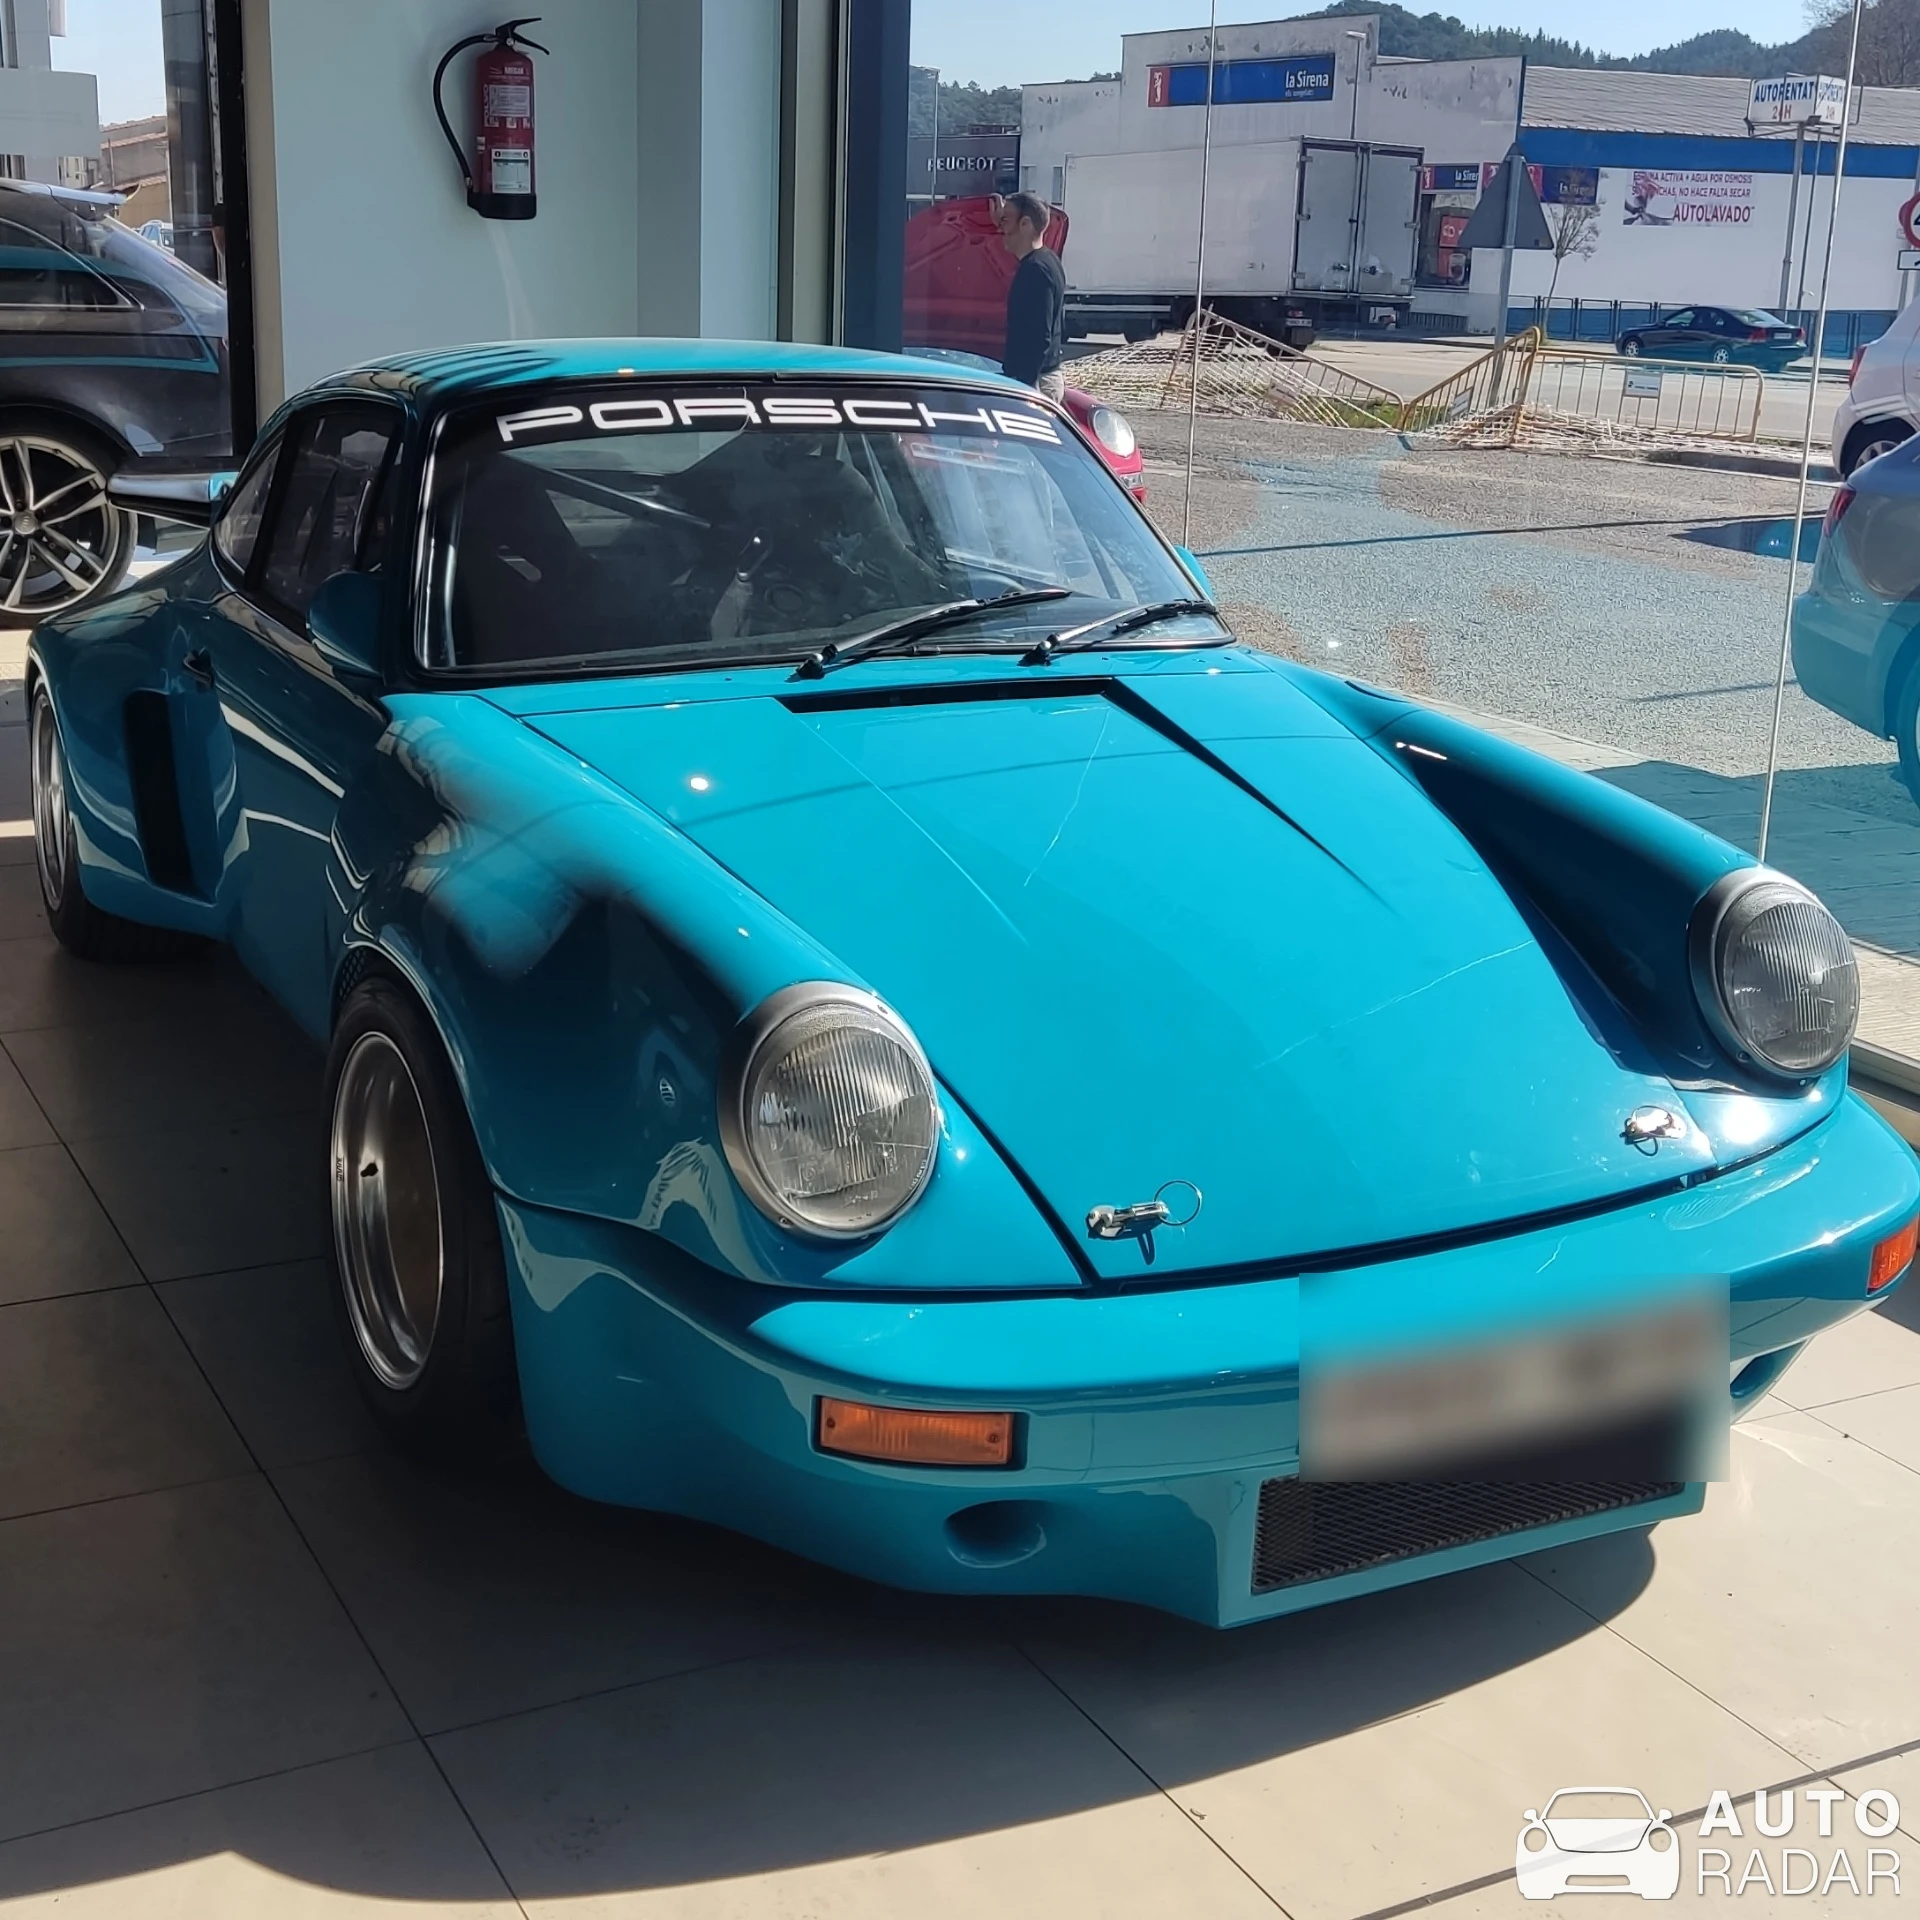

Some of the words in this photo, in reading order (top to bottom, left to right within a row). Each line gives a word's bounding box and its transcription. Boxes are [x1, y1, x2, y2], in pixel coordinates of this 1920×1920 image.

[1296, 70, 1329, 88] Sirena
[1771, 103, 1792, 120] 2H
[927, 156, 997, 172] PEUGEOT
[1660, 172, 1684, 182] ACTIVA
[1691, 173, 1709, 183] AGUA
[1710, 173, 1723, 183] POR
[1679, 187, 1689, 197] NO
[1691, 187, 1708, 197] HACE
[1709, 187, 1728, 198] FALTA
[1673, 203, 1751, 223] AUTOLAVADO
[496, 397, 1062, 446] PORSCHE
